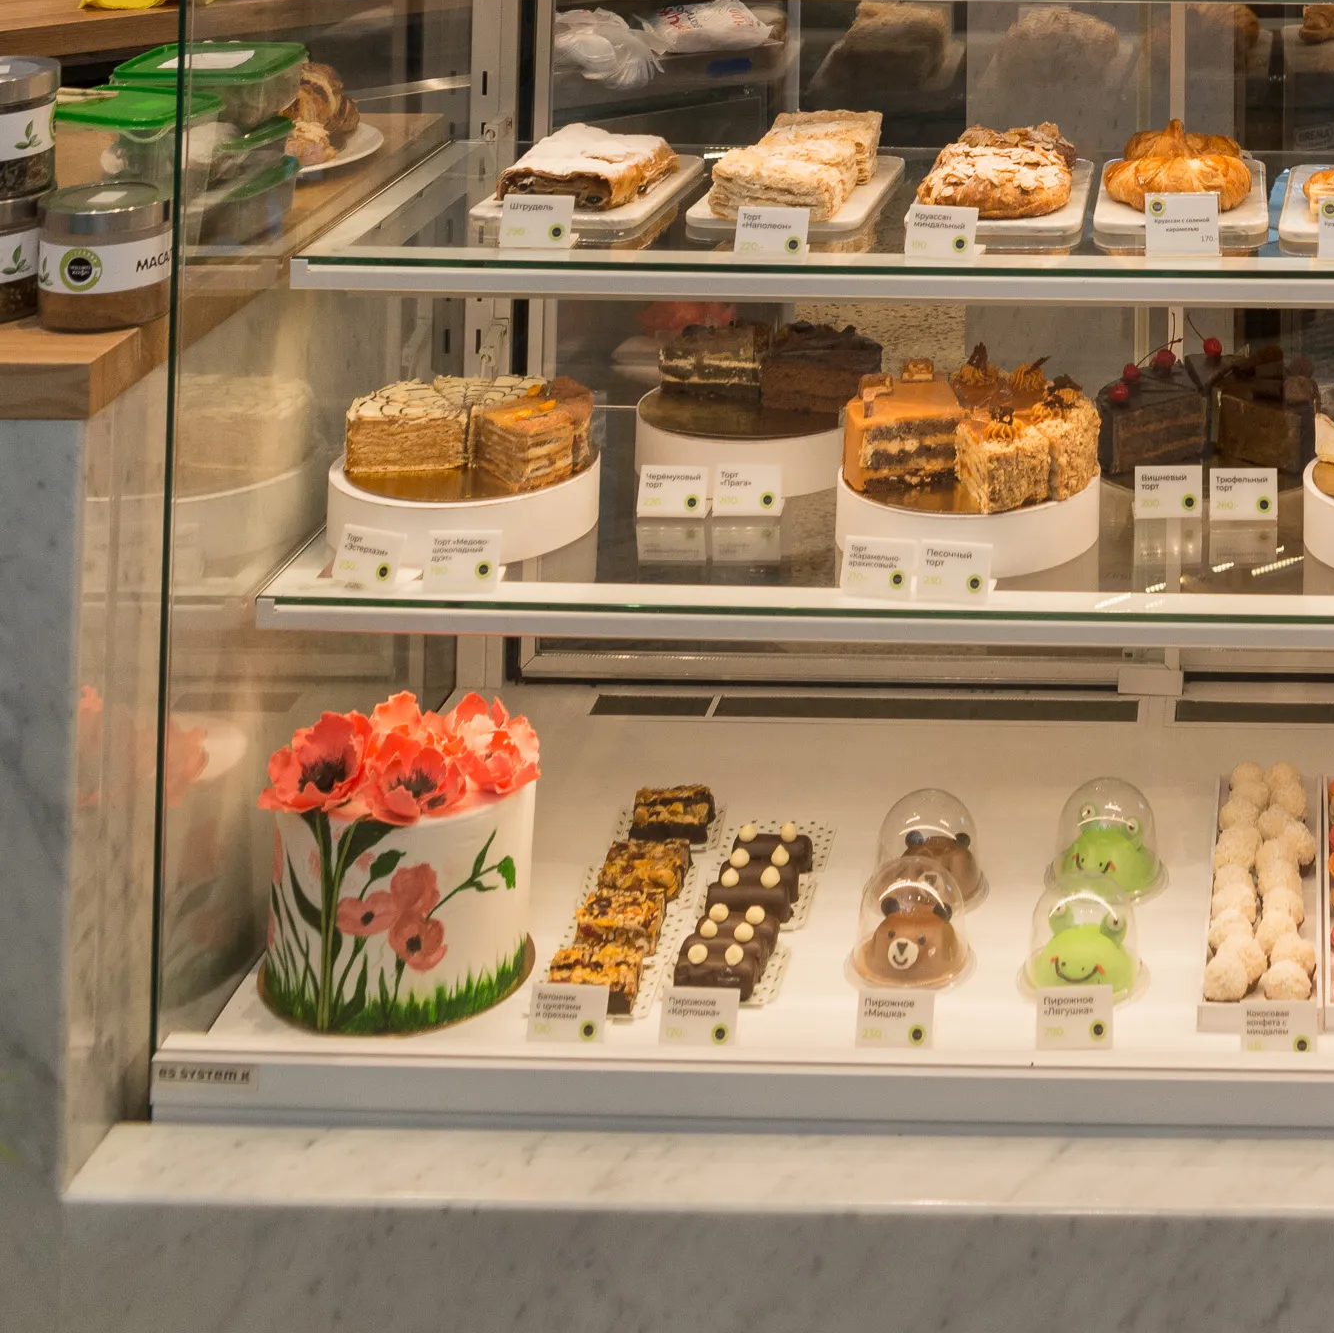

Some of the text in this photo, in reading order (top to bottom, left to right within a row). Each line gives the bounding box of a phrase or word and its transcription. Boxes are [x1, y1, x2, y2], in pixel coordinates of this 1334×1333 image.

[510, 202, 554, 211] Штрудель
[743, 213, 761, 221] Торт
[915, 213, 951, 221] Круассан
[741, 222, 791, 231] «Наполеон»
[914, 222, 966, 230] миндальный
[646, 473, 701, 482] Черёмуховый
[721, 471, 739, 479] Торт
[1141, 474, 1187, 482] Вишневый
[720, 479, 752, 488] «Прага»
[1216, 476, 1268, 485] Трюфельный
[347, 533, 363, 543] Торт
[434, 538, 451, 546] Торт
[344, 543, 388, 557] «Эстерхази»
[851, 544, 867, 552] Торт
[926, 548, 973, 559] Песочный
[431, 555, 453, 563] дуэт»
[926, 559, 945, 567] торт
[848, 561, 898, 569] арахисовый»
[538, 992, 576, 1001] Батончик
[1044, 996, 1094, 1006] Пирожное
[669, 997, 716, 1007] Пирожное
[864, 998, 915, 1008] Пирожное
[542, 1003, 581, 1011] цукатами
[542, 1012, 578, 1020] орехами
[668, 1008, 720, 1017] «Картошка»
[864, 1009, 906, 1018] «Мишка»
[1043, 1007, 1093, 1018] «Лягушка»
[1247, 1010, 1290, 1018] Кокосовая
[1247, 1019, 1281, 1027] конфета
